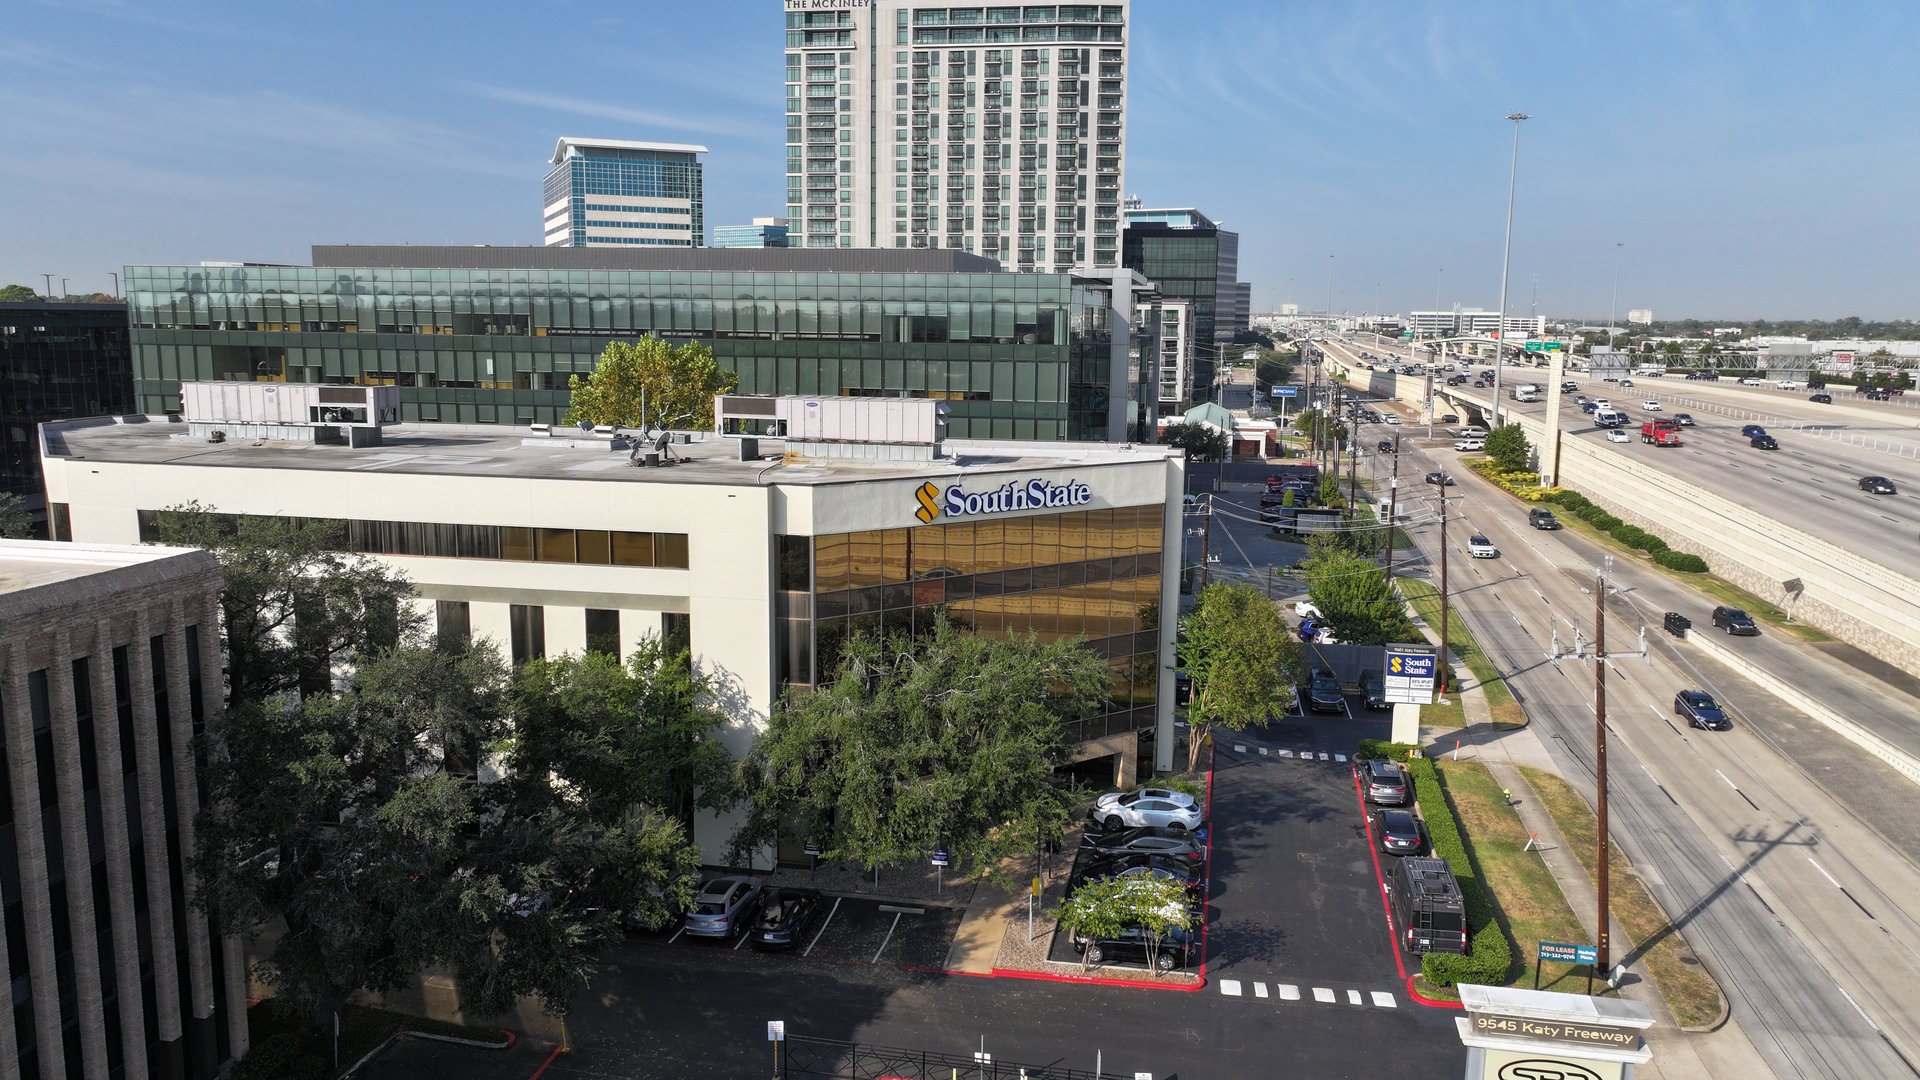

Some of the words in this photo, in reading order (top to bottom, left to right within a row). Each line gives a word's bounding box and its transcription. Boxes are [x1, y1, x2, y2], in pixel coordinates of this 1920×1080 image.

[787, 0, 806, 8] THE
[944, 477, 1092, 518] SouthState
[1405, 657, 1431, 667] South
[1404, 665, 1428, 675] State
[1477, 1018, 1518, 1032] 9545
[1522, 1021, 1560, 1037] Katy
[1564, 1026, 1634, 1045] Freeway
